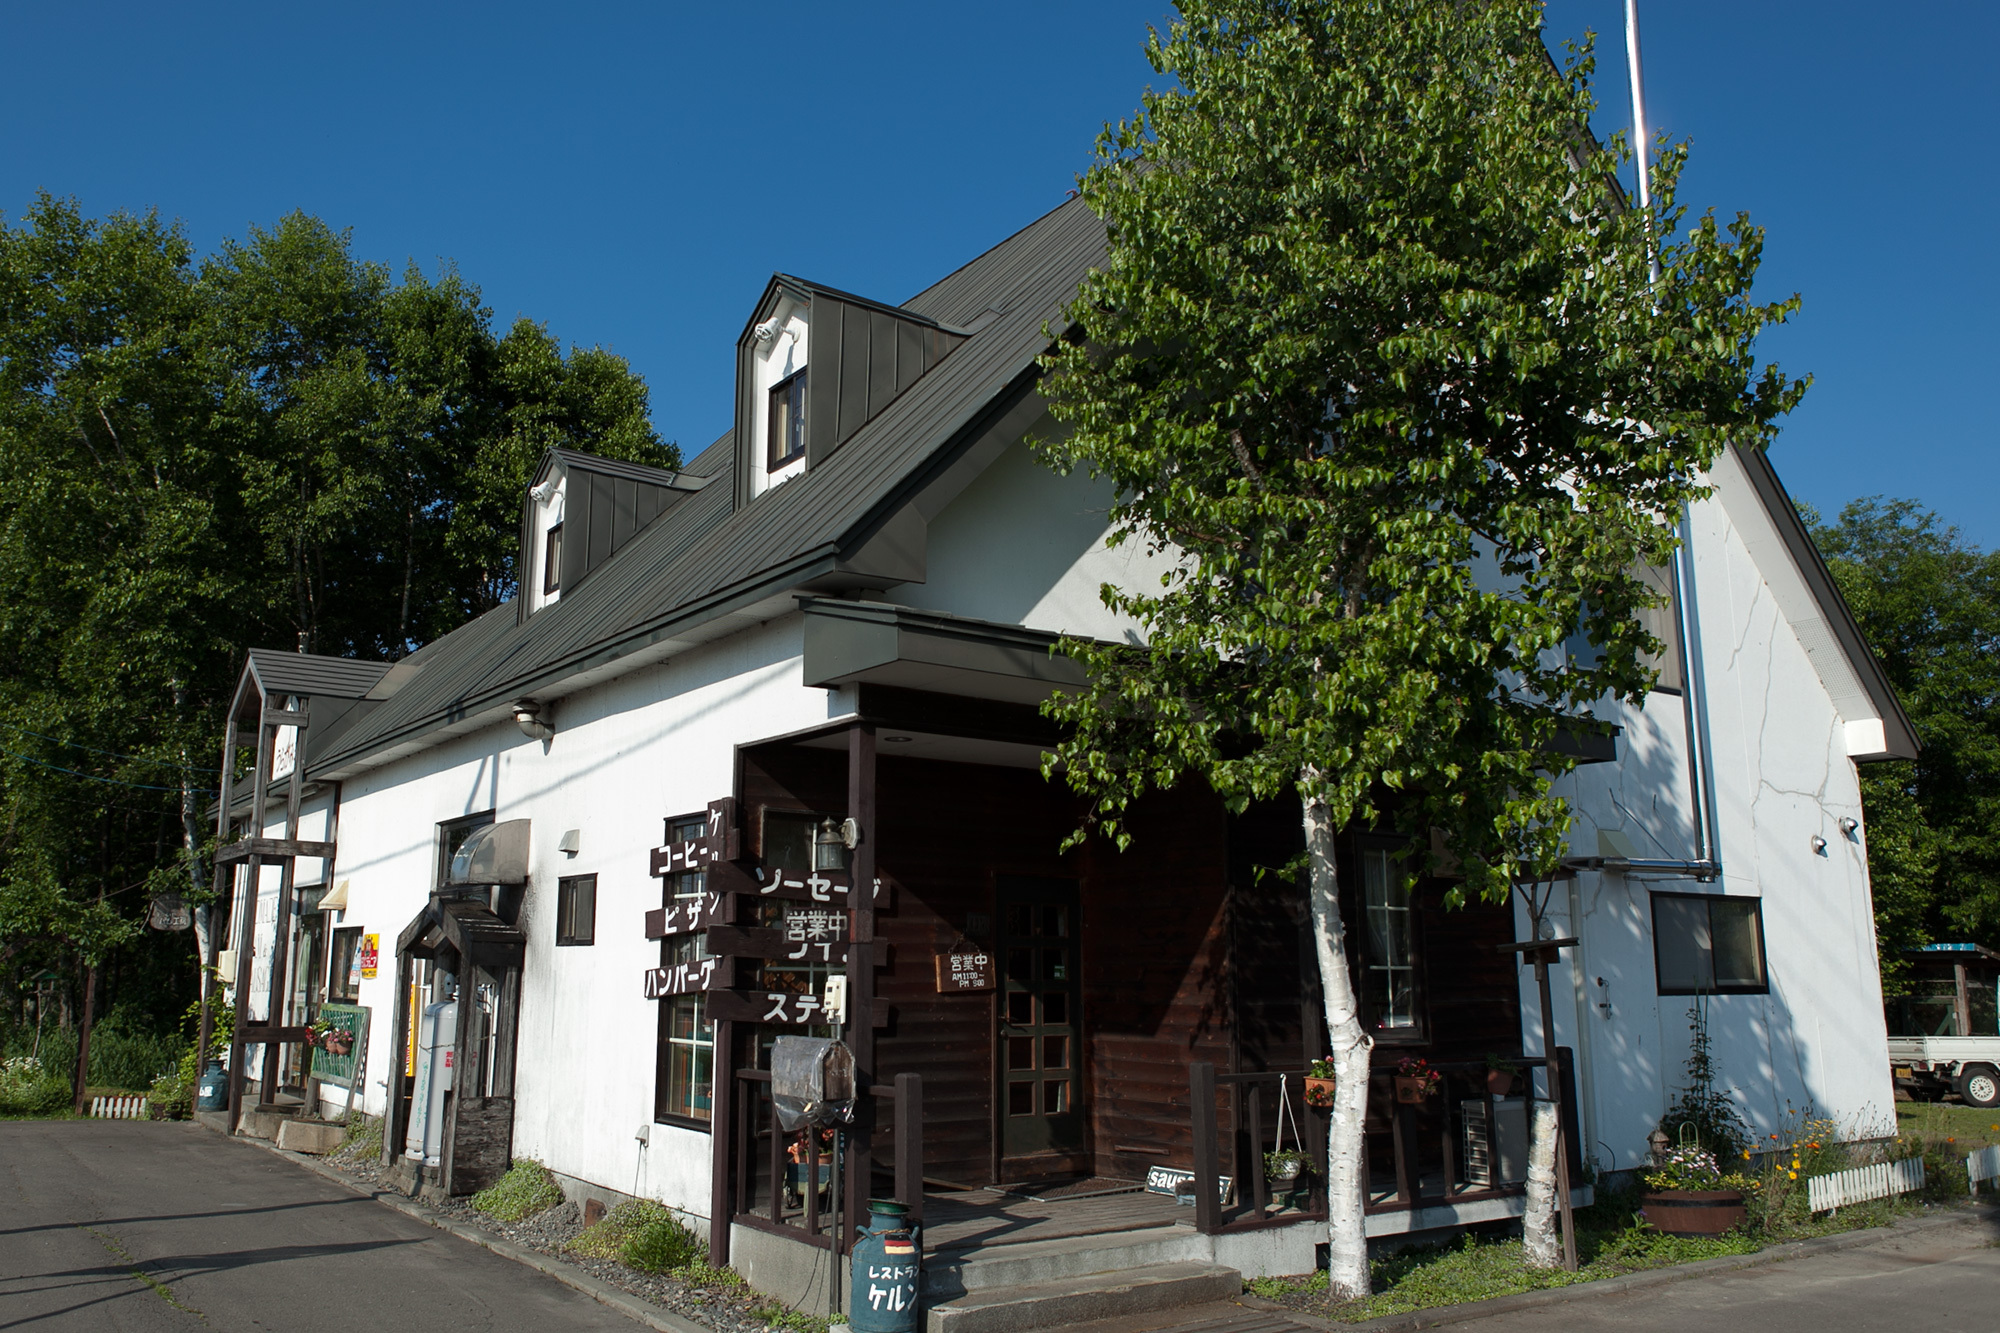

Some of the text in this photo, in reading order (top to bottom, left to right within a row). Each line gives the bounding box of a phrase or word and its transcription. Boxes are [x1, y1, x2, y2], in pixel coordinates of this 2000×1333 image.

[658, 840, 708, 874] コーヒー
[664, 899, 703, 935] ピザ
[786, 910, 848, 942] 営業中
[645, 958, 716, 997] ハンバーグ
[950, 953, 988, 972] 営業中
[868, 1265, 920, 1281] レストラン
[868, 1283, 918, 1312] ケルン
